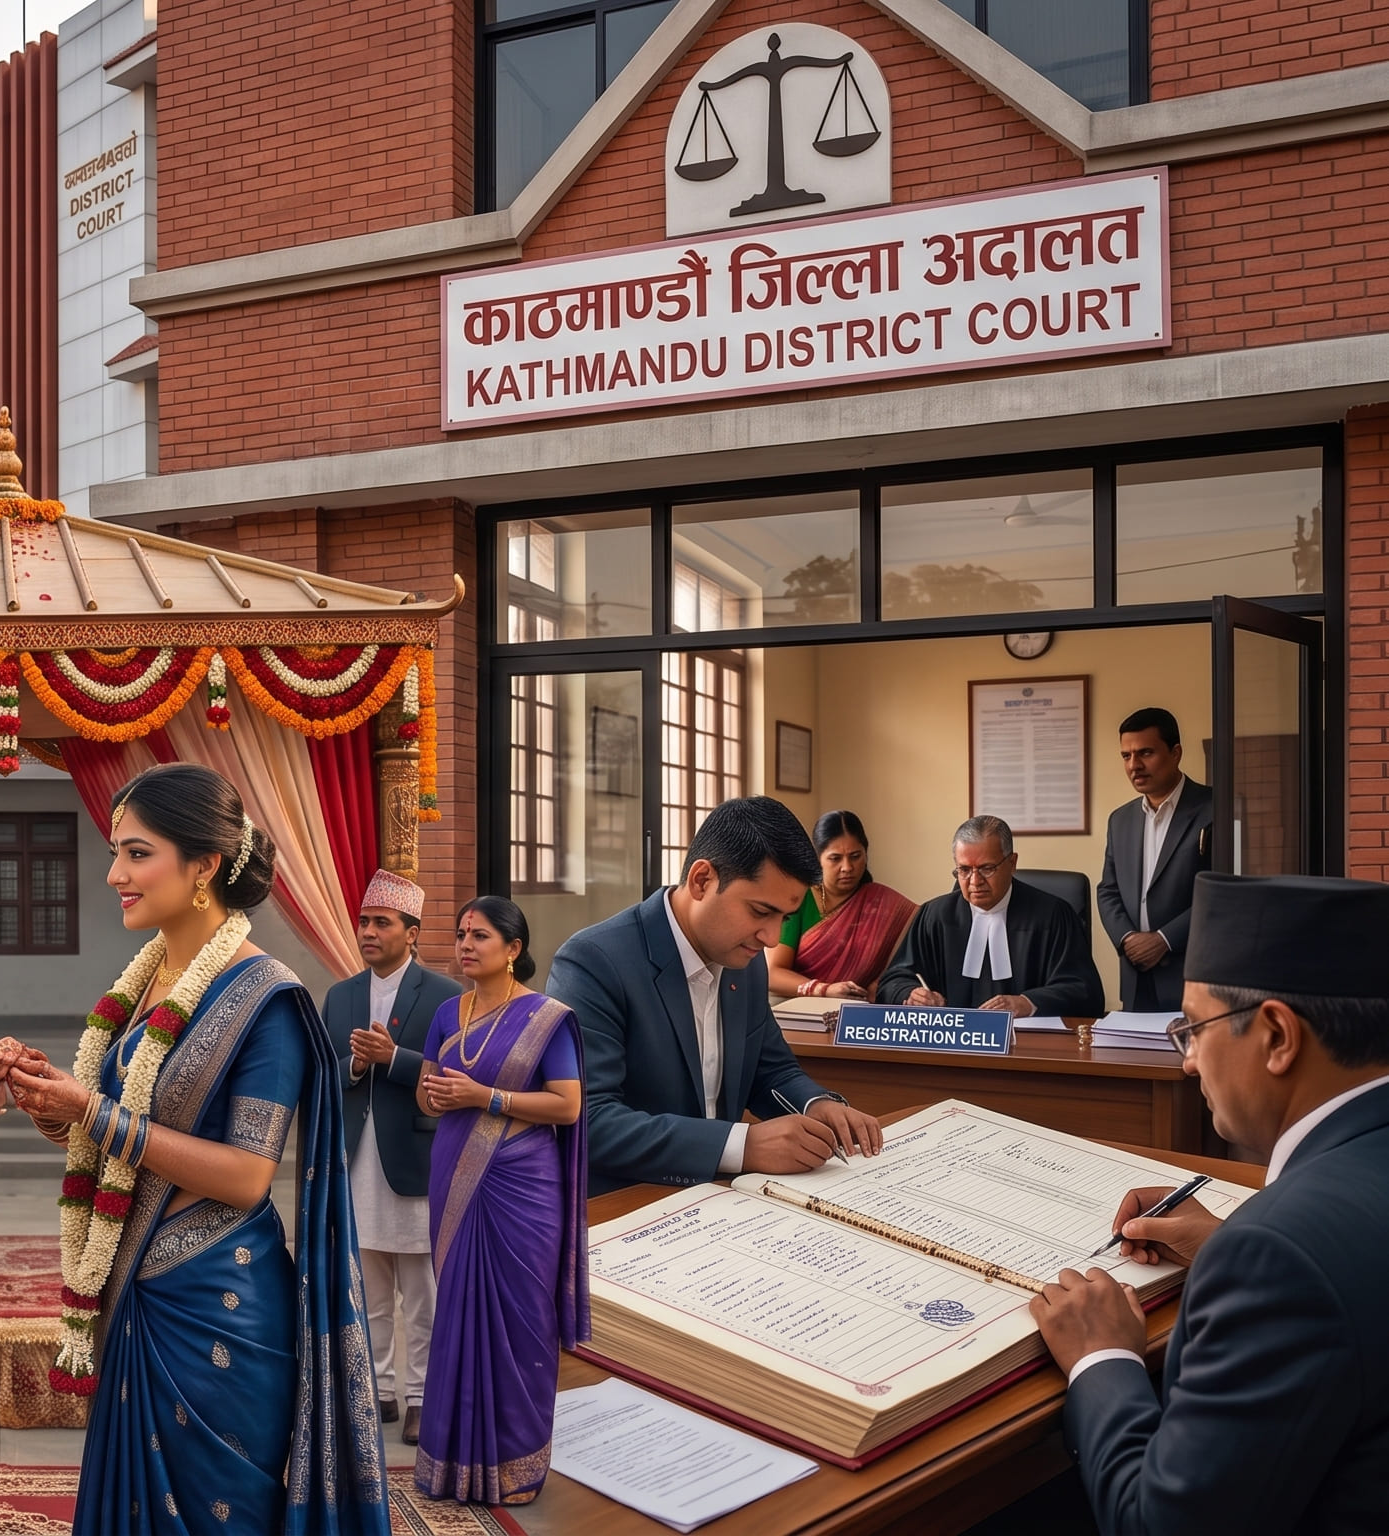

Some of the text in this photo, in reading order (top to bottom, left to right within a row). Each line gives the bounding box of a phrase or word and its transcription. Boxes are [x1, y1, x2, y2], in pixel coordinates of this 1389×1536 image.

[69, 168, 135, 218] DISTRICT
[76, 201, 125, 240] COURT
[728, 242, 904, 313] जिल्ला
[922, 205, 1145, 286] अदालत
[467, 283, 1140, 407] KATHMANDU DISTRICT COURT
[844, 1026, 1001, 1047] REGISTRATION CELL
[883, 1011, 965, 1028] MARRIAGE
